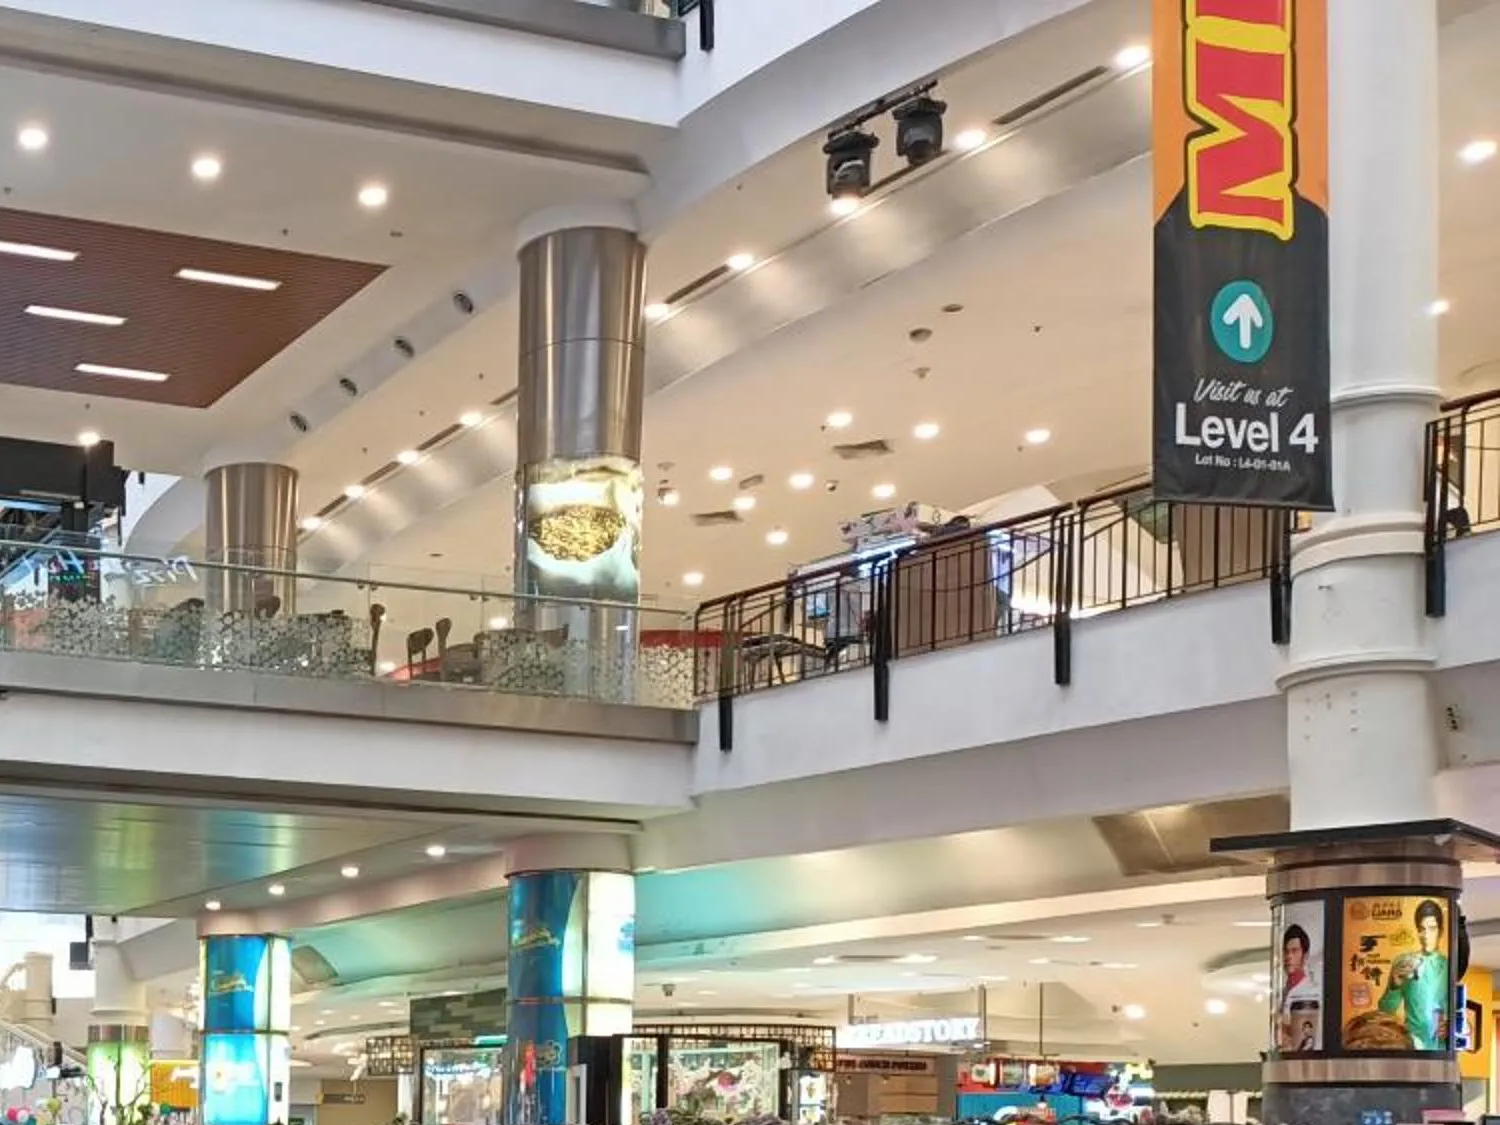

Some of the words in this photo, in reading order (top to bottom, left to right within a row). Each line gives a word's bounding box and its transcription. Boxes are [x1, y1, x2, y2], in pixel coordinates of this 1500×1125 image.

[1194, 378, 1246, 403] Visit
[1244, 388, 1262, 405] us
[1265, 386, 1294, 407] at
[1175, 402, 1280, 453] Level
[1288, 412, 1319, 454] 4
[1195, 453, 1213, 466] Lot
